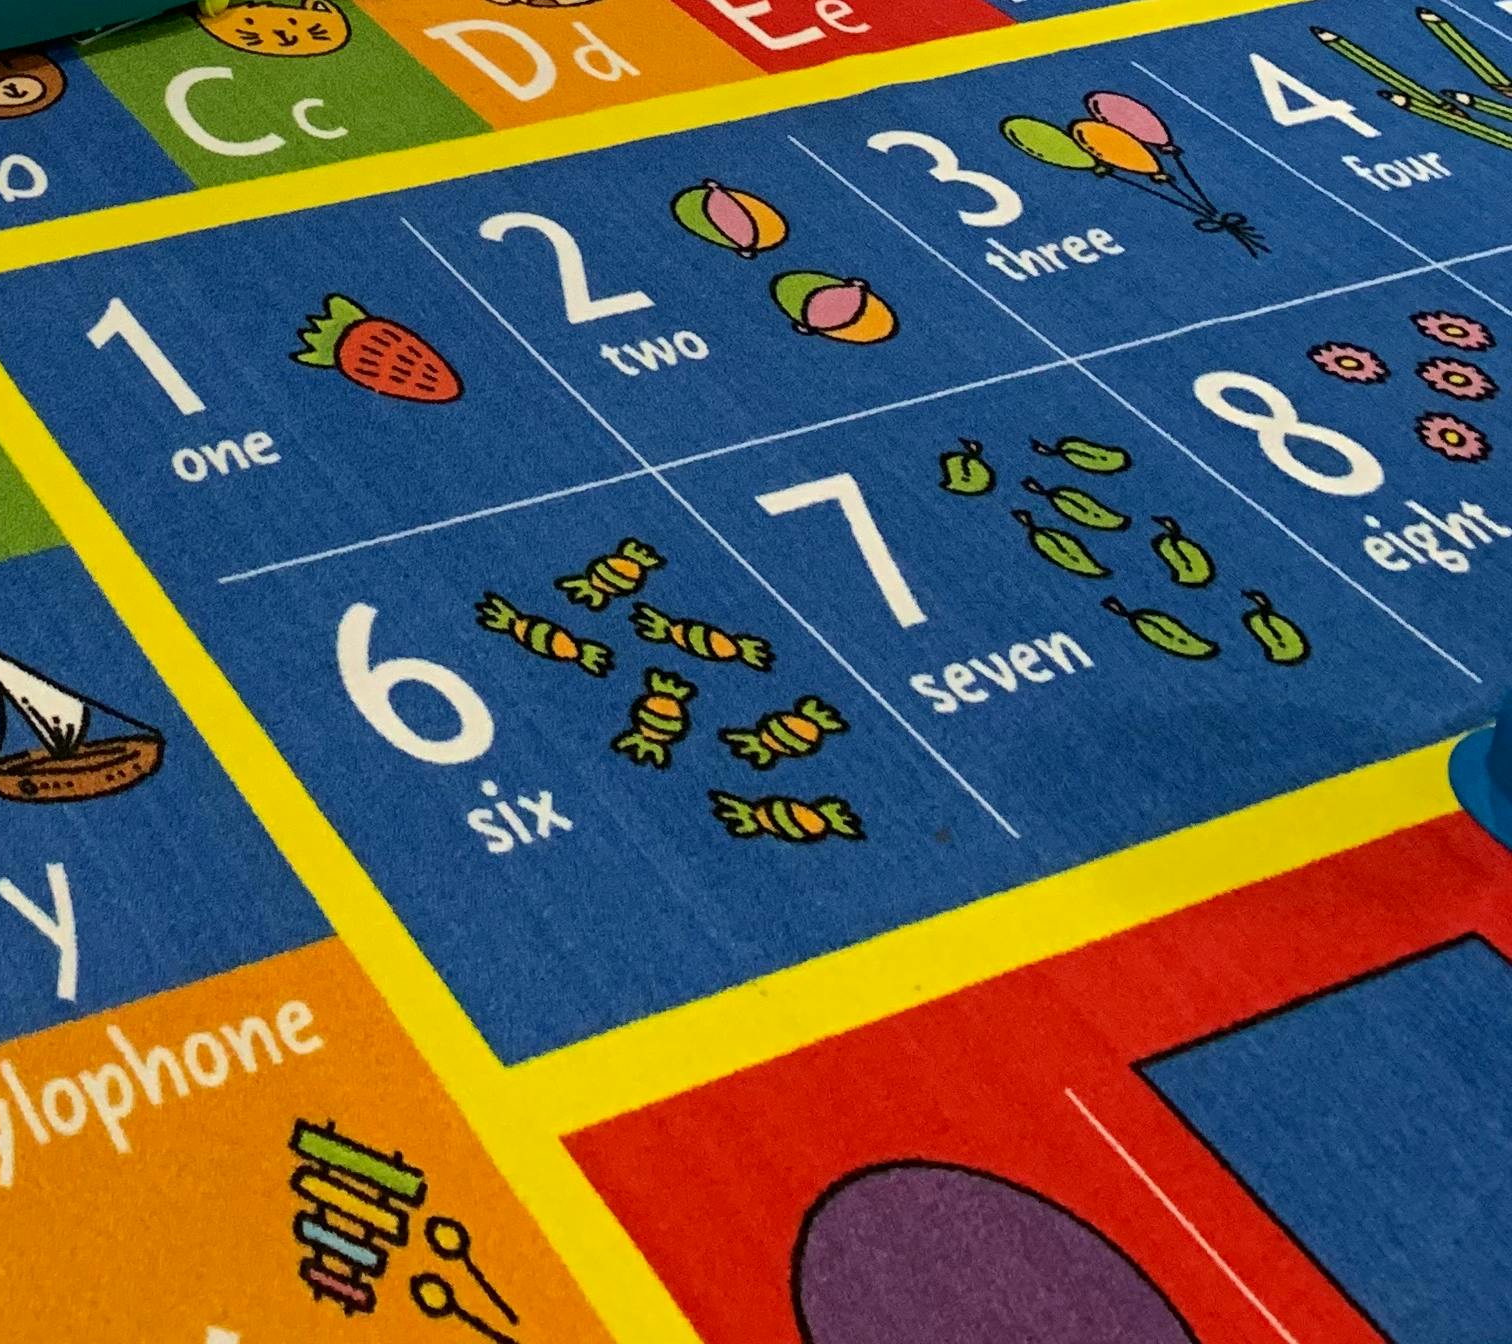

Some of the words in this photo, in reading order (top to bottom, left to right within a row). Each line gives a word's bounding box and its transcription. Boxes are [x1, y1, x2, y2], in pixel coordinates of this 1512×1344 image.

[1248, 52, 1381, 139] 4
[866, 130, 1024, 229] 3
[1342, 149, 1452, 193] four
[985, 224, 1125, 284] three
[600, 332, 710, 378] two
[171, 429, 282, 484] one
[754, 471, 928, 629] 7
[1361, 498, 1512, 574] eight
[336, 601, 497, 766] 6
[909, 628, 1097, 717] seven
[466, 779, 574, 857] six
